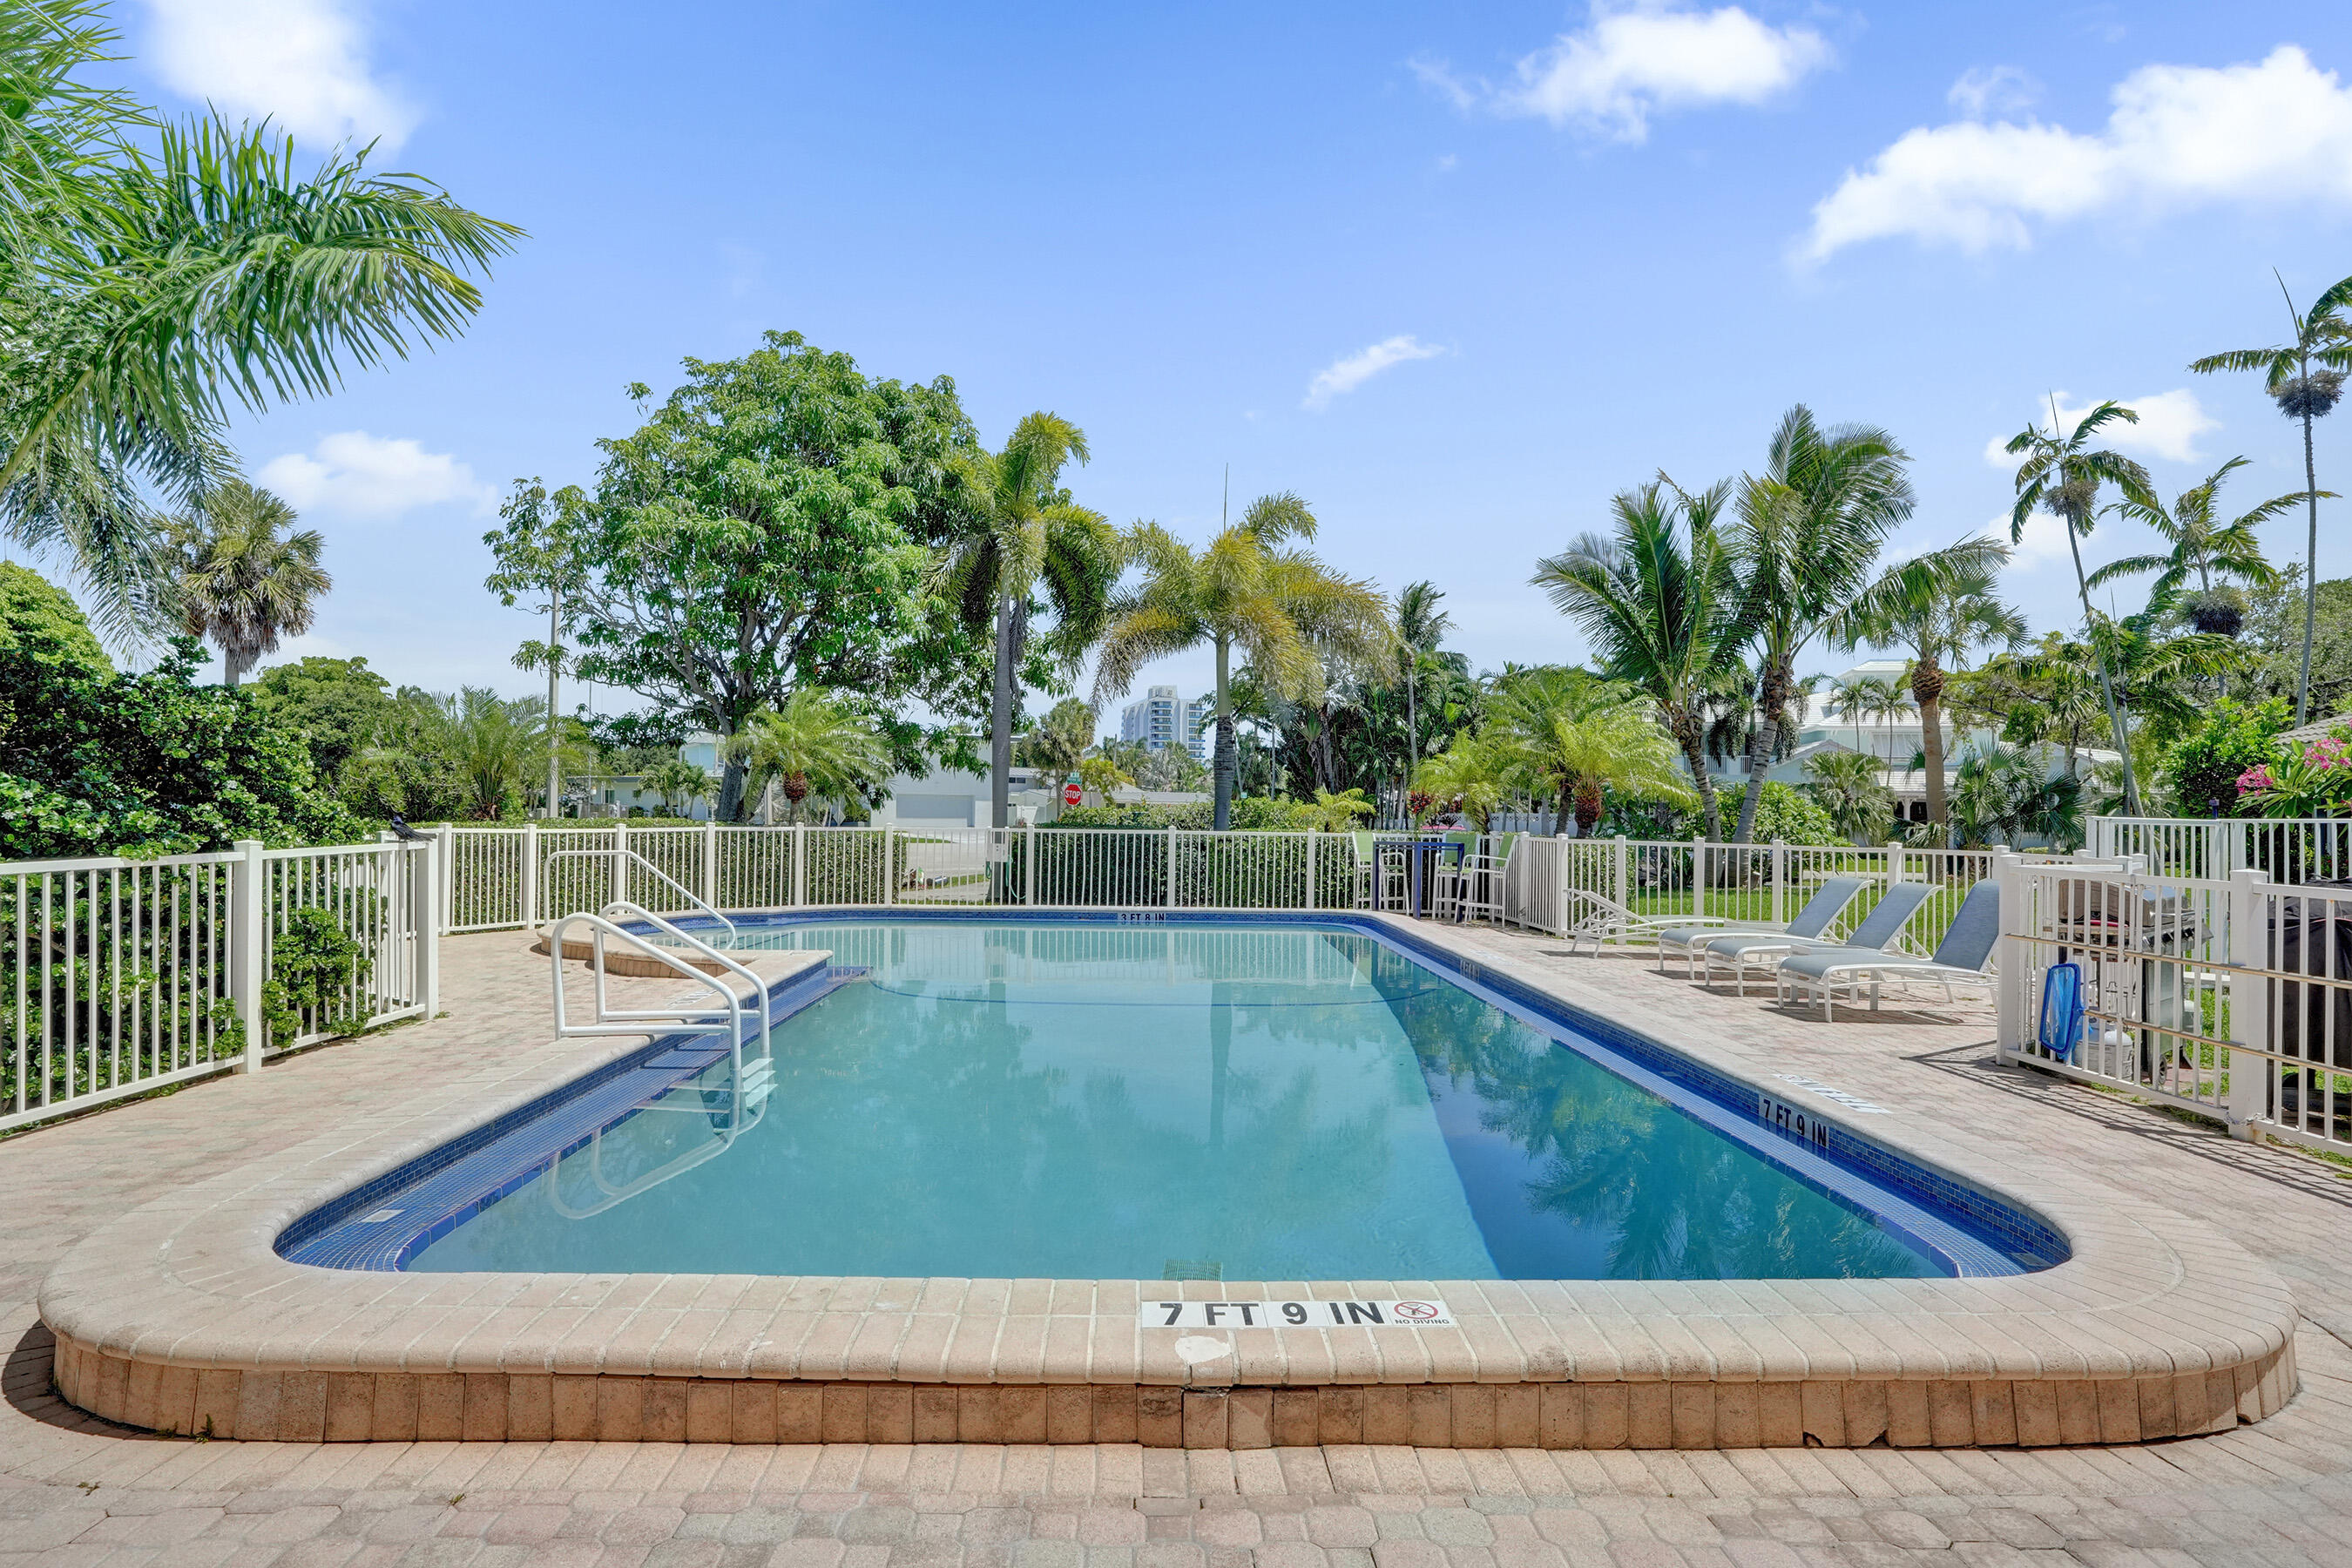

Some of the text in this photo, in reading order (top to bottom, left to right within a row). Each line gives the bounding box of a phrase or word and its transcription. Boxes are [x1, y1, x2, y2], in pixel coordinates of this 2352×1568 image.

[1064, 790, 1081, 799] STOP
[1763, 1098, 1827, 1147] 7 FT 9 IN
[1159, 1301, 1386, 1326] 7 FT 9 IN
